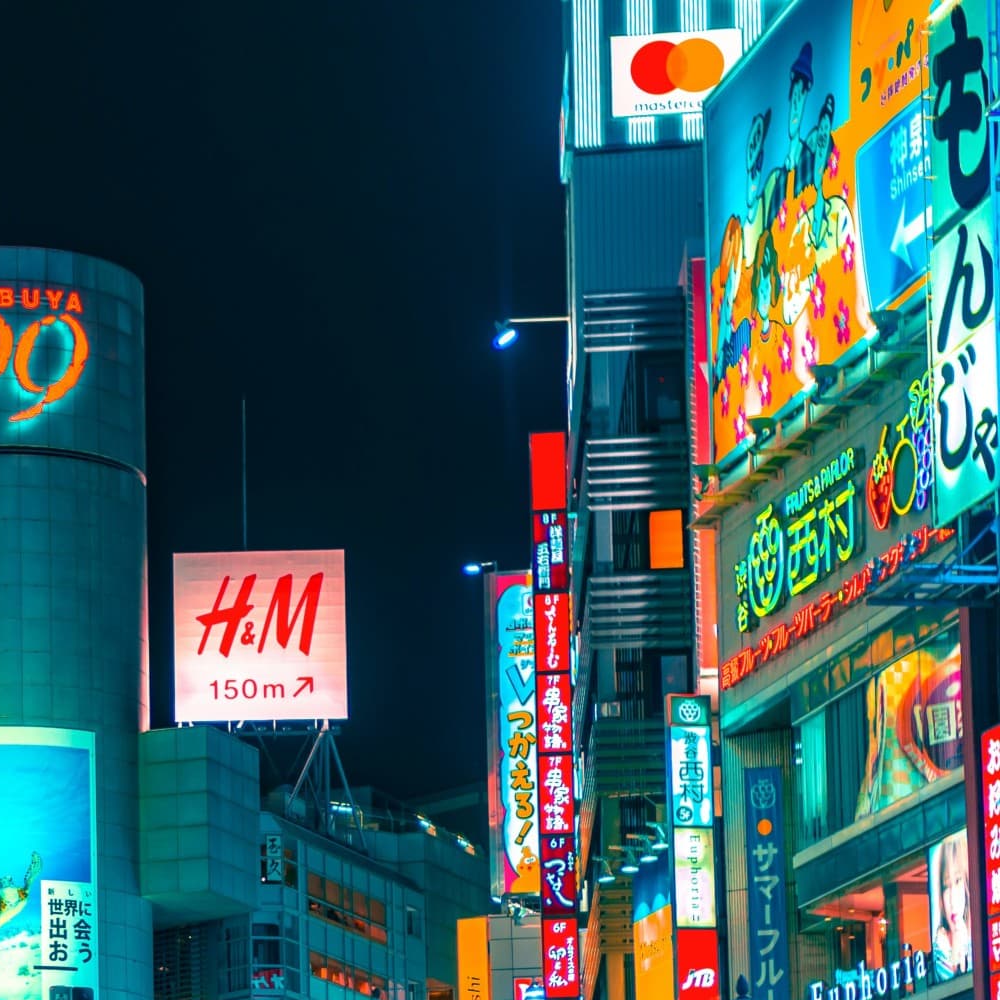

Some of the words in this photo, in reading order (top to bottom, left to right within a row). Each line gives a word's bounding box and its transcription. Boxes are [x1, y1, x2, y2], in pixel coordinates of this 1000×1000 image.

[932, 4, 998, 482] もんじゃ
[786, 479, 856, 597] 西村
[195, 572, 324, 658] H&M
[546, 675, 561, 685] 7F
[548, 756, 563, 767] 7F
[550, 837, 565, 848] 6F
[689, 834, 700, 922] Euphoria
[47, 898, 93, 918] 世界に
[49, 918, 92, 941] 出会
[552, 922, 567, 933] 6F
[49, 942, 92, 963] おう
[681, 968, 715, 990] JTB
